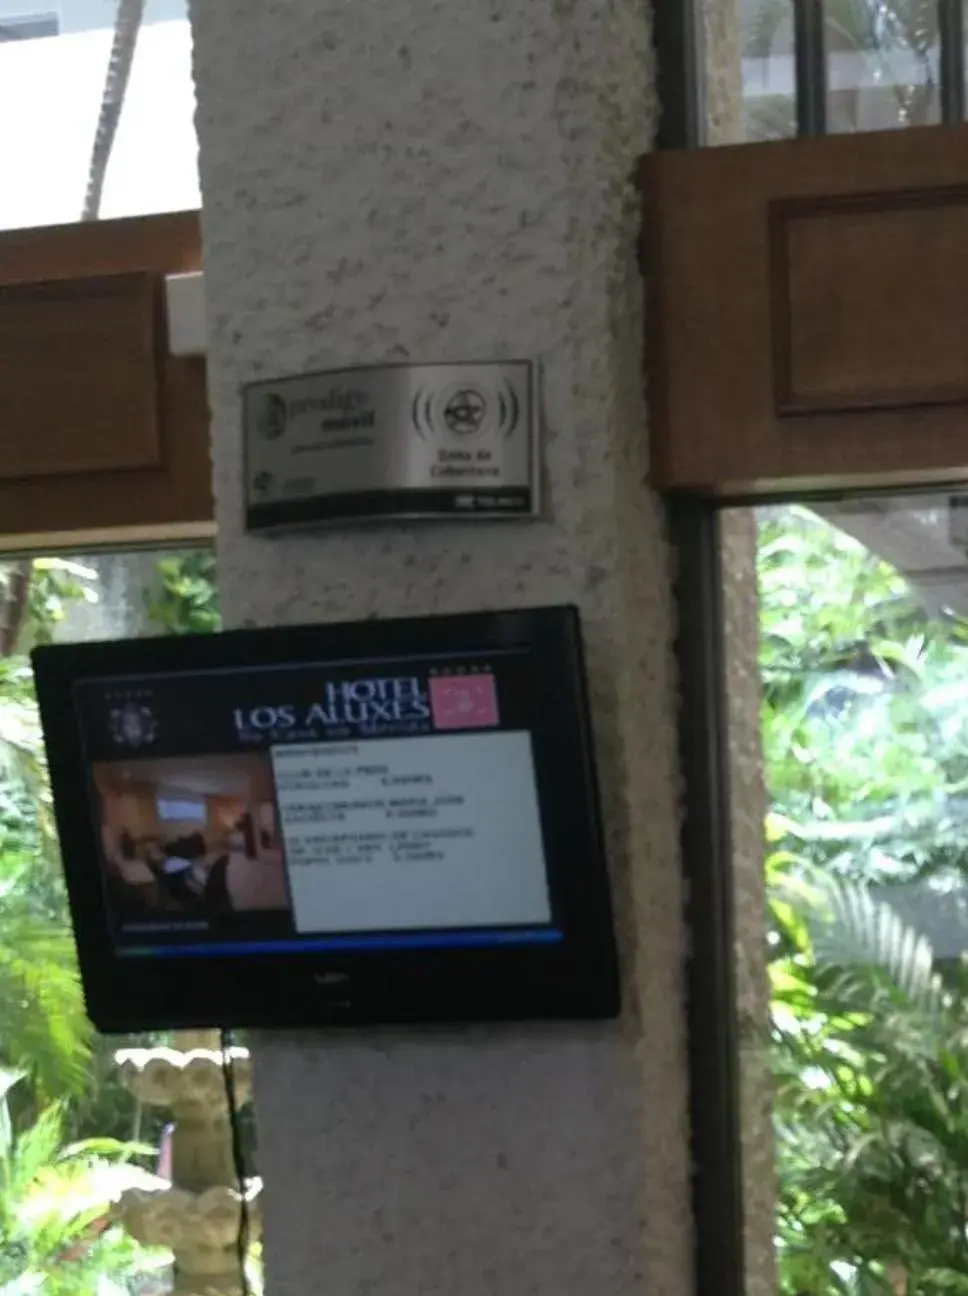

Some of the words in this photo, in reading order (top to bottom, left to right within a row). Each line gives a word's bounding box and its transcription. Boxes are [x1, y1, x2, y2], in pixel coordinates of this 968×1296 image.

[325, 677, 423, 701] HOTEL
[234, 705, 297, 730] LOS
[305, 698, 430, 727] ALUXES
